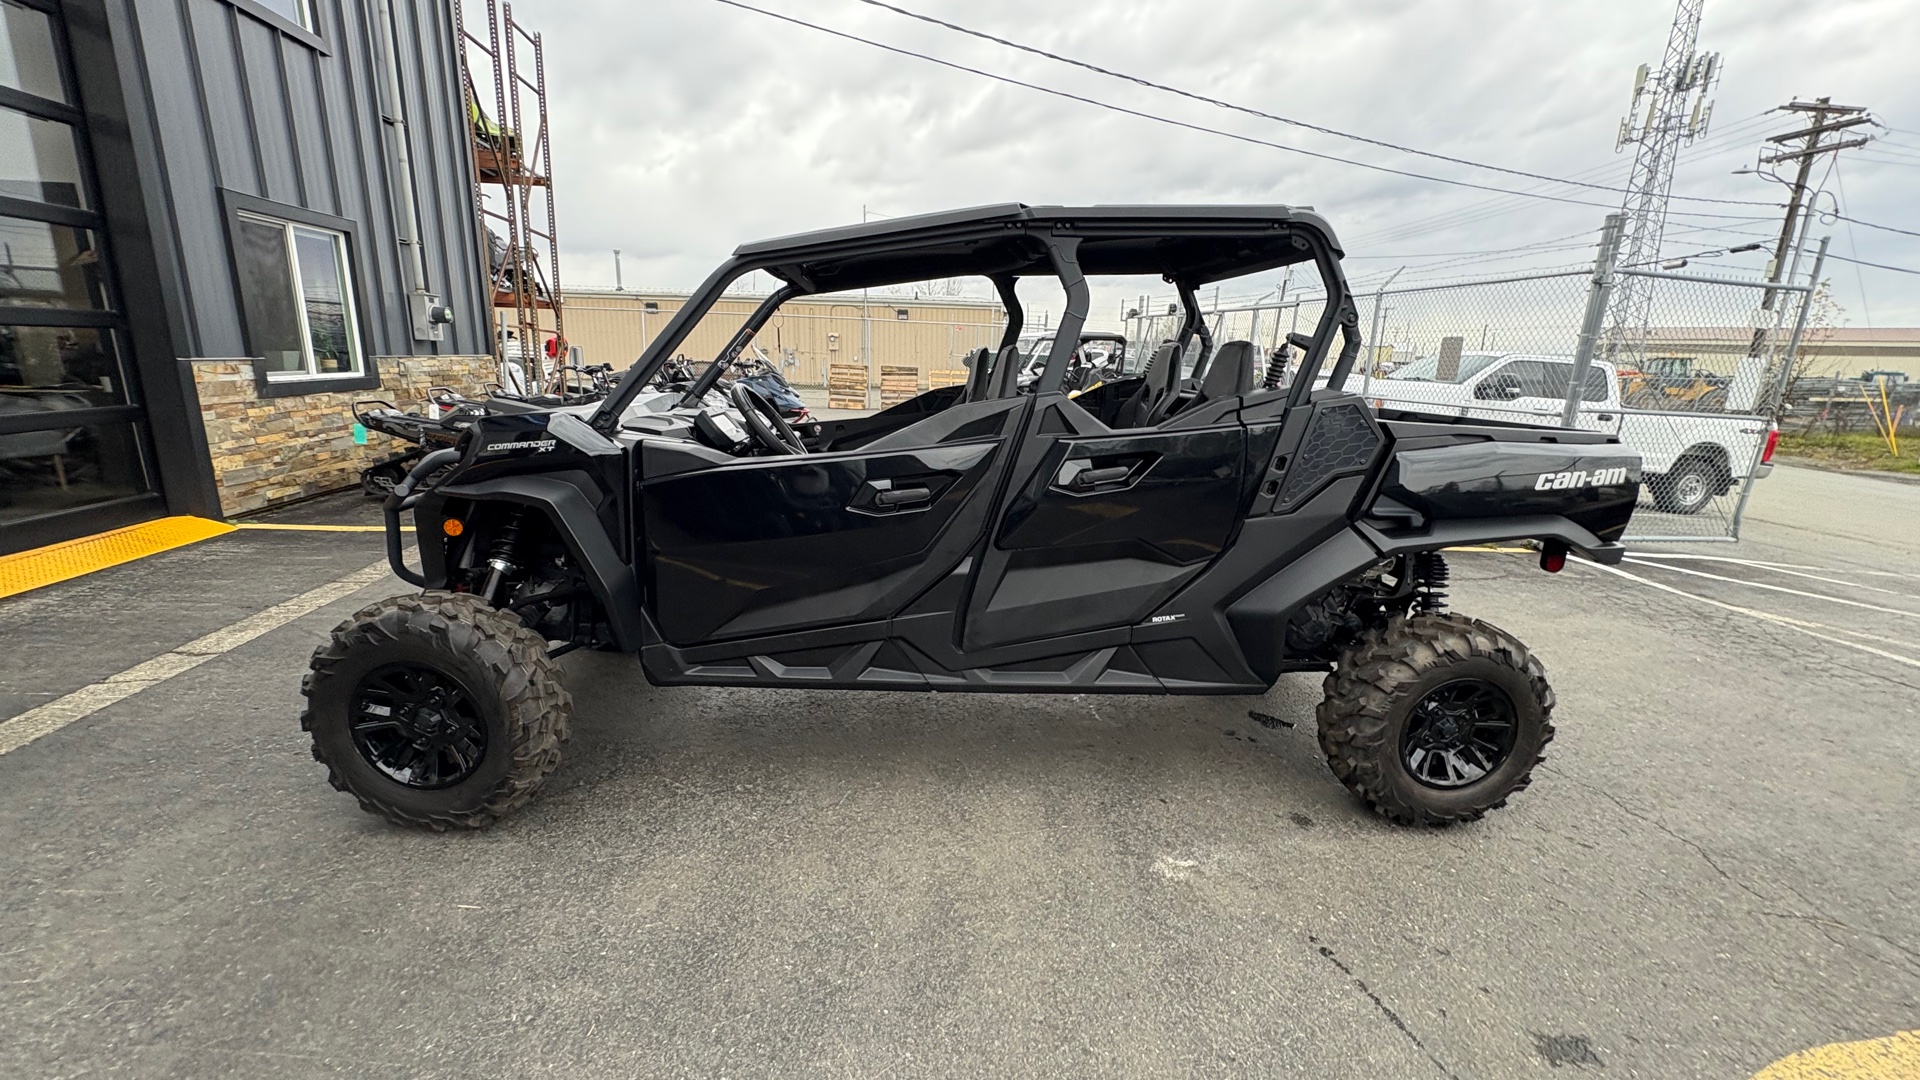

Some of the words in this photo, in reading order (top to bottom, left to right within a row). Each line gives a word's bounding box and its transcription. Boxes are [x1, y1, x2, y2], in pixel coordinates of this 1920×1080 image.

[487, 439, 557, 451] COMMANDER
[1534, 466, 1627, 491] can-am
[1152, 614, 1176, 623] ROTAX
